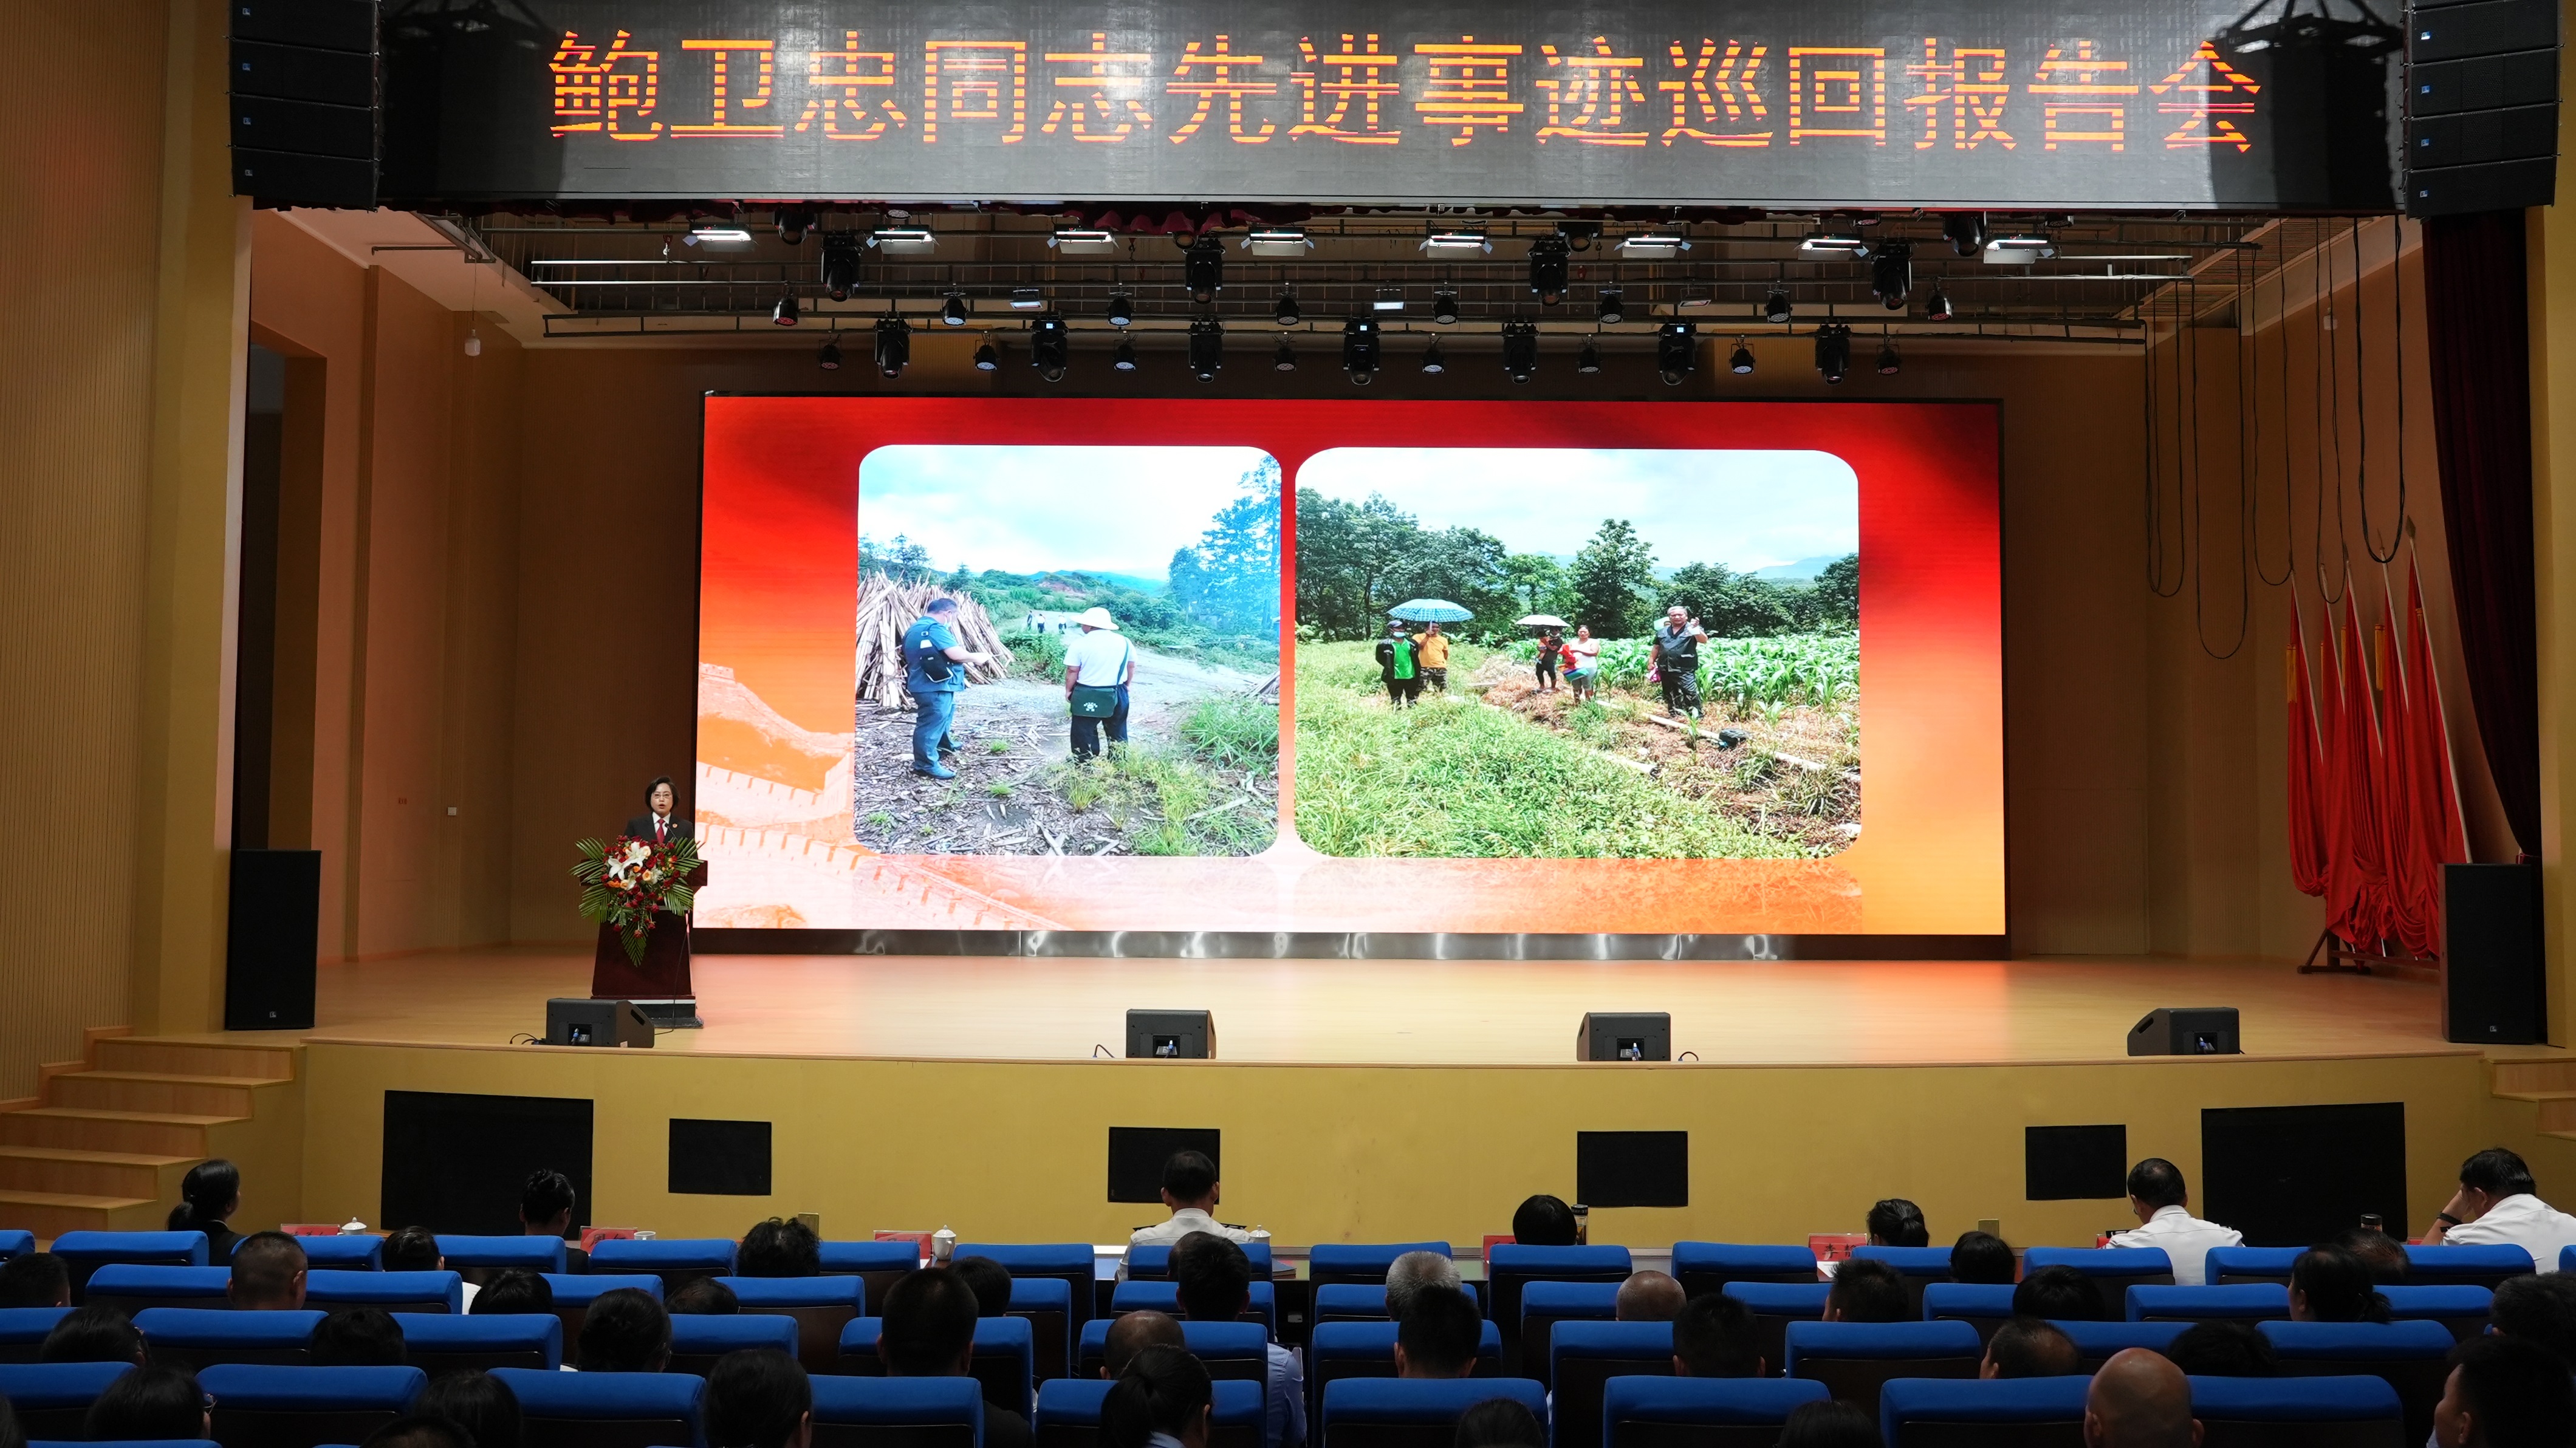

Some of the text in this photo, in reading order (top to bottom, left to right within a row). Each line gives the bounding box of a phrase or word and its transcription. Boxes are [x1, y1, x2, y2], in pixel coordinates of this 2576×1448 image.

[547, 29, 2261, 153] 鲍卫忠同志先进事迹巡回报告会
